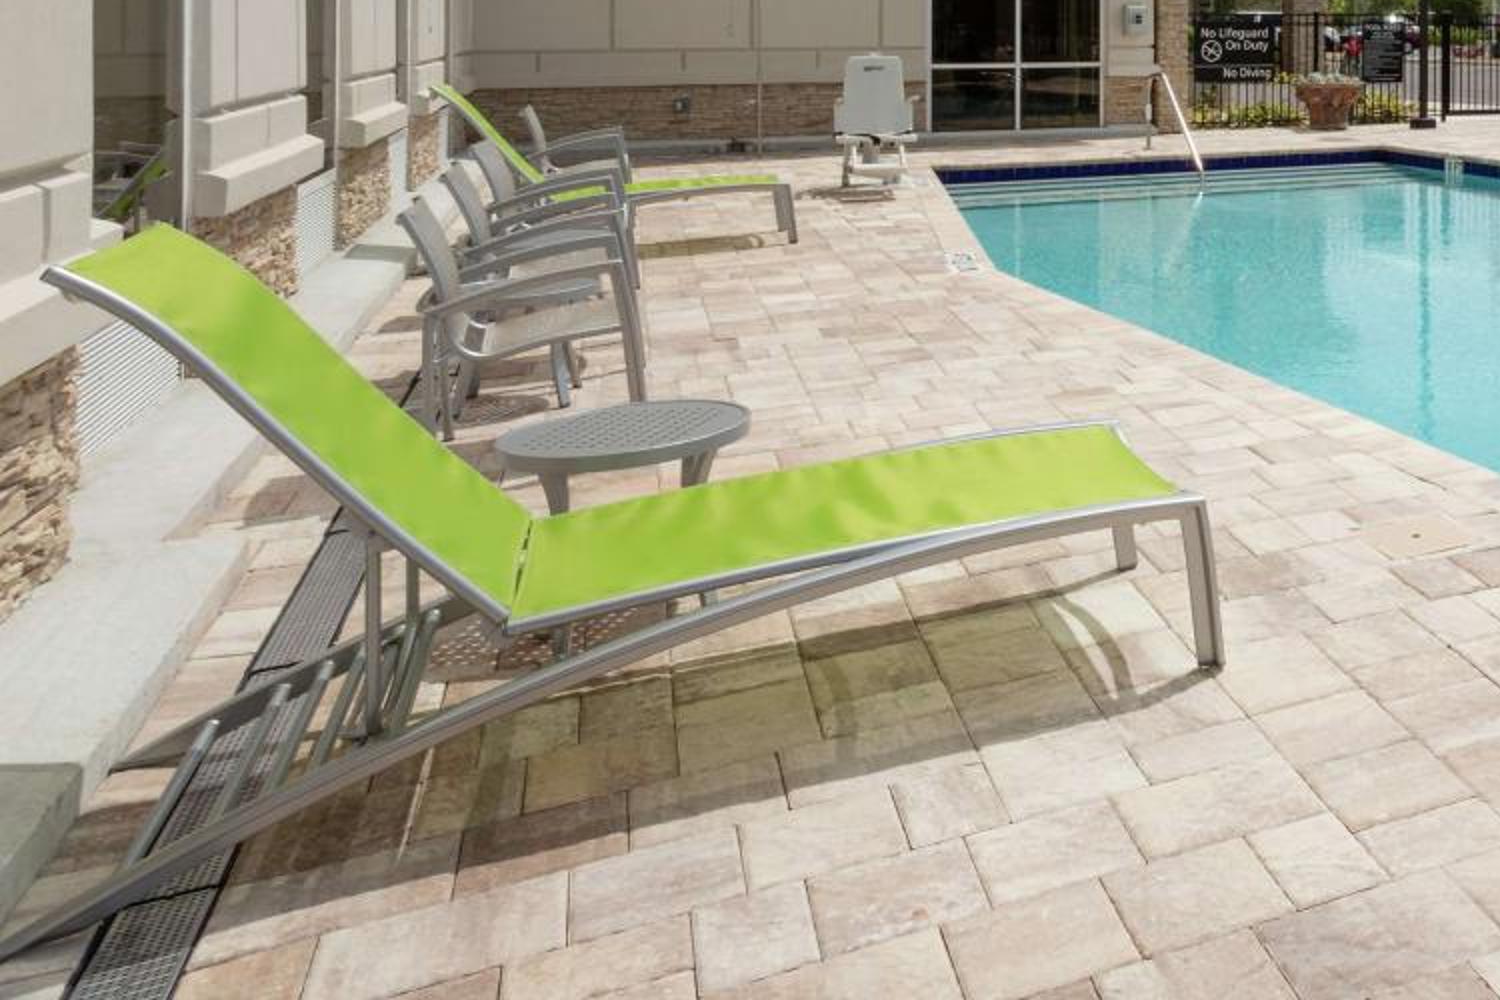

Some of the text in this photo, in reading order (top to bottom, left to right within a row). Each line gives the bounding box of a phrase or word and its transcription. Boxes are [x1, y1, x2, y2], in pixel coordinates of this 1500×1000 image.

[1200, 27, 1269, 41] No Lifeguard
[1226, 40, 1269, 53] On Duty
[1223, 67, 1271, 80] No Diving
